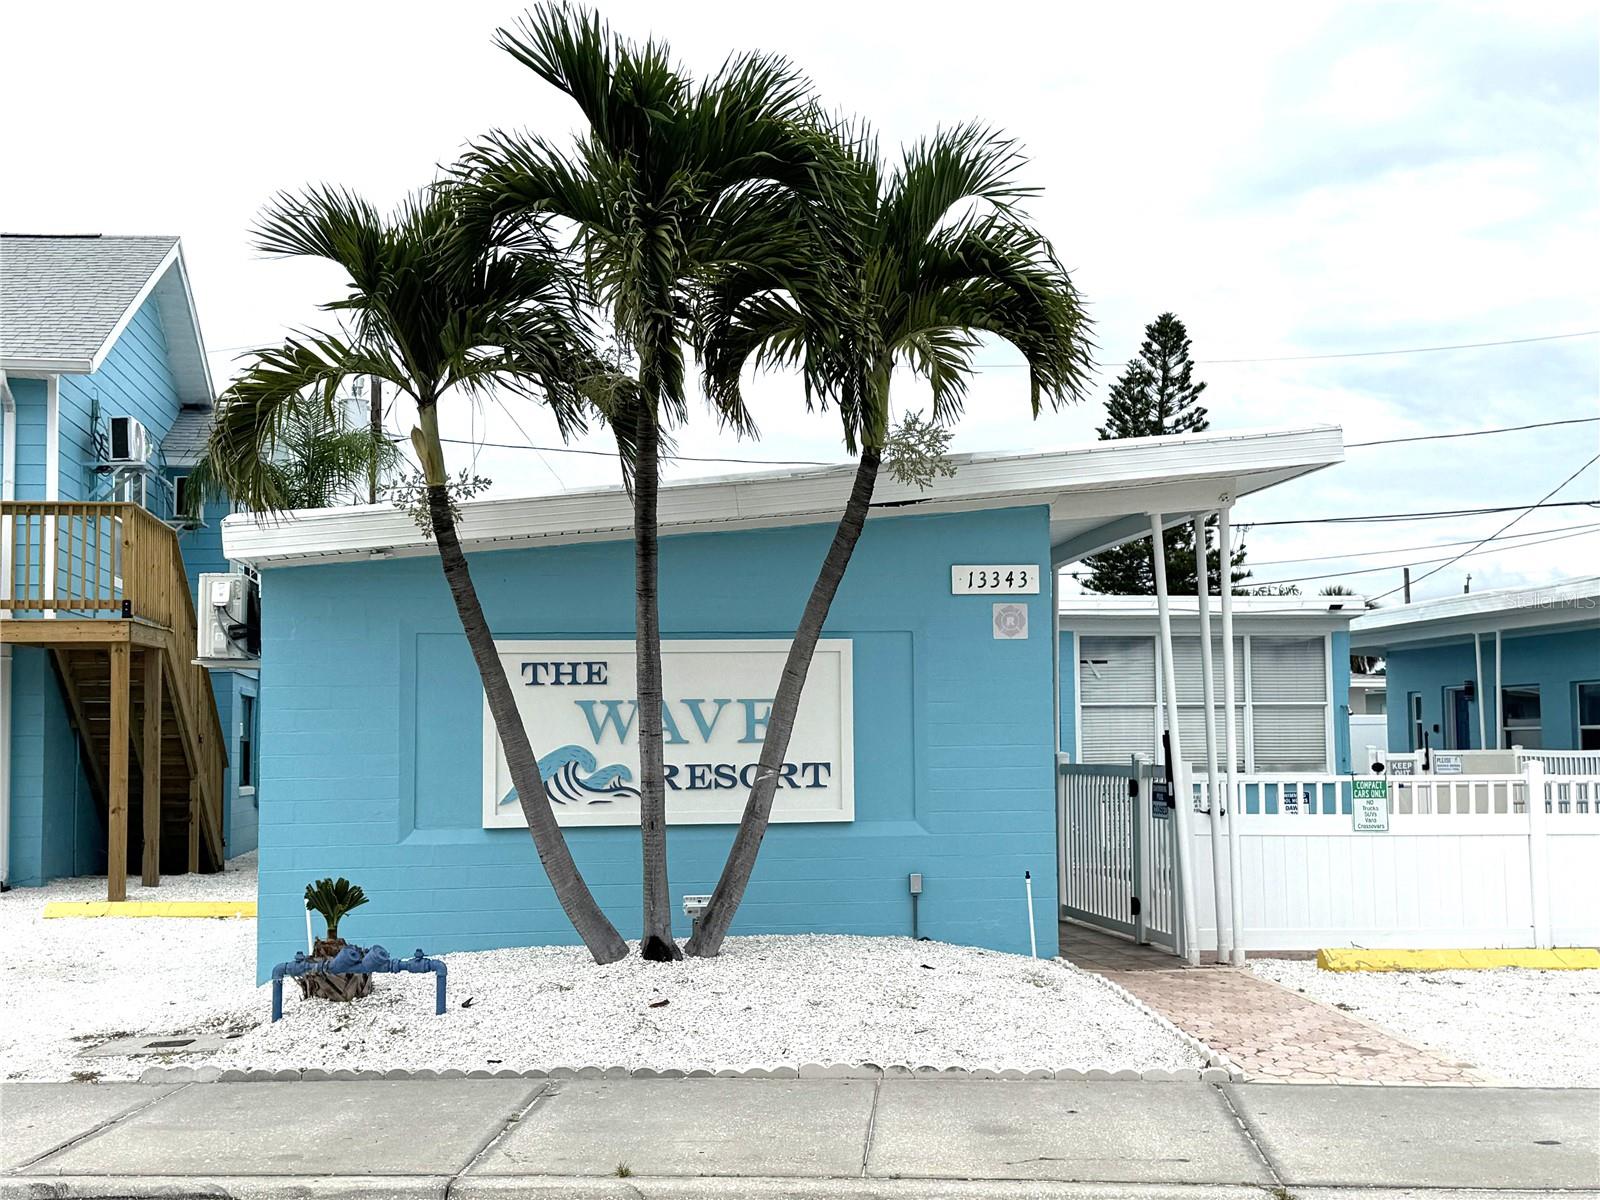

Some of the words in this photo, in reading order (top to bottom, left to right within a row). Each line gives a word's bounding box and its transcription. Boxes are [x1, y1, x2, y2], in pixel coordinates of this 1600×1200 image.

[967, 570, 1028, 589] 13343
[521, 661, 608, 686] THE
[574, 698, 776, 745] WAVE
[1392, 762, 1412, 770] KEEP
[1356, 781, 1383, 789] COMPACT
[1354, 789, 1370, 798] CARS
[1371, 789, 1386, 798] ONLY
